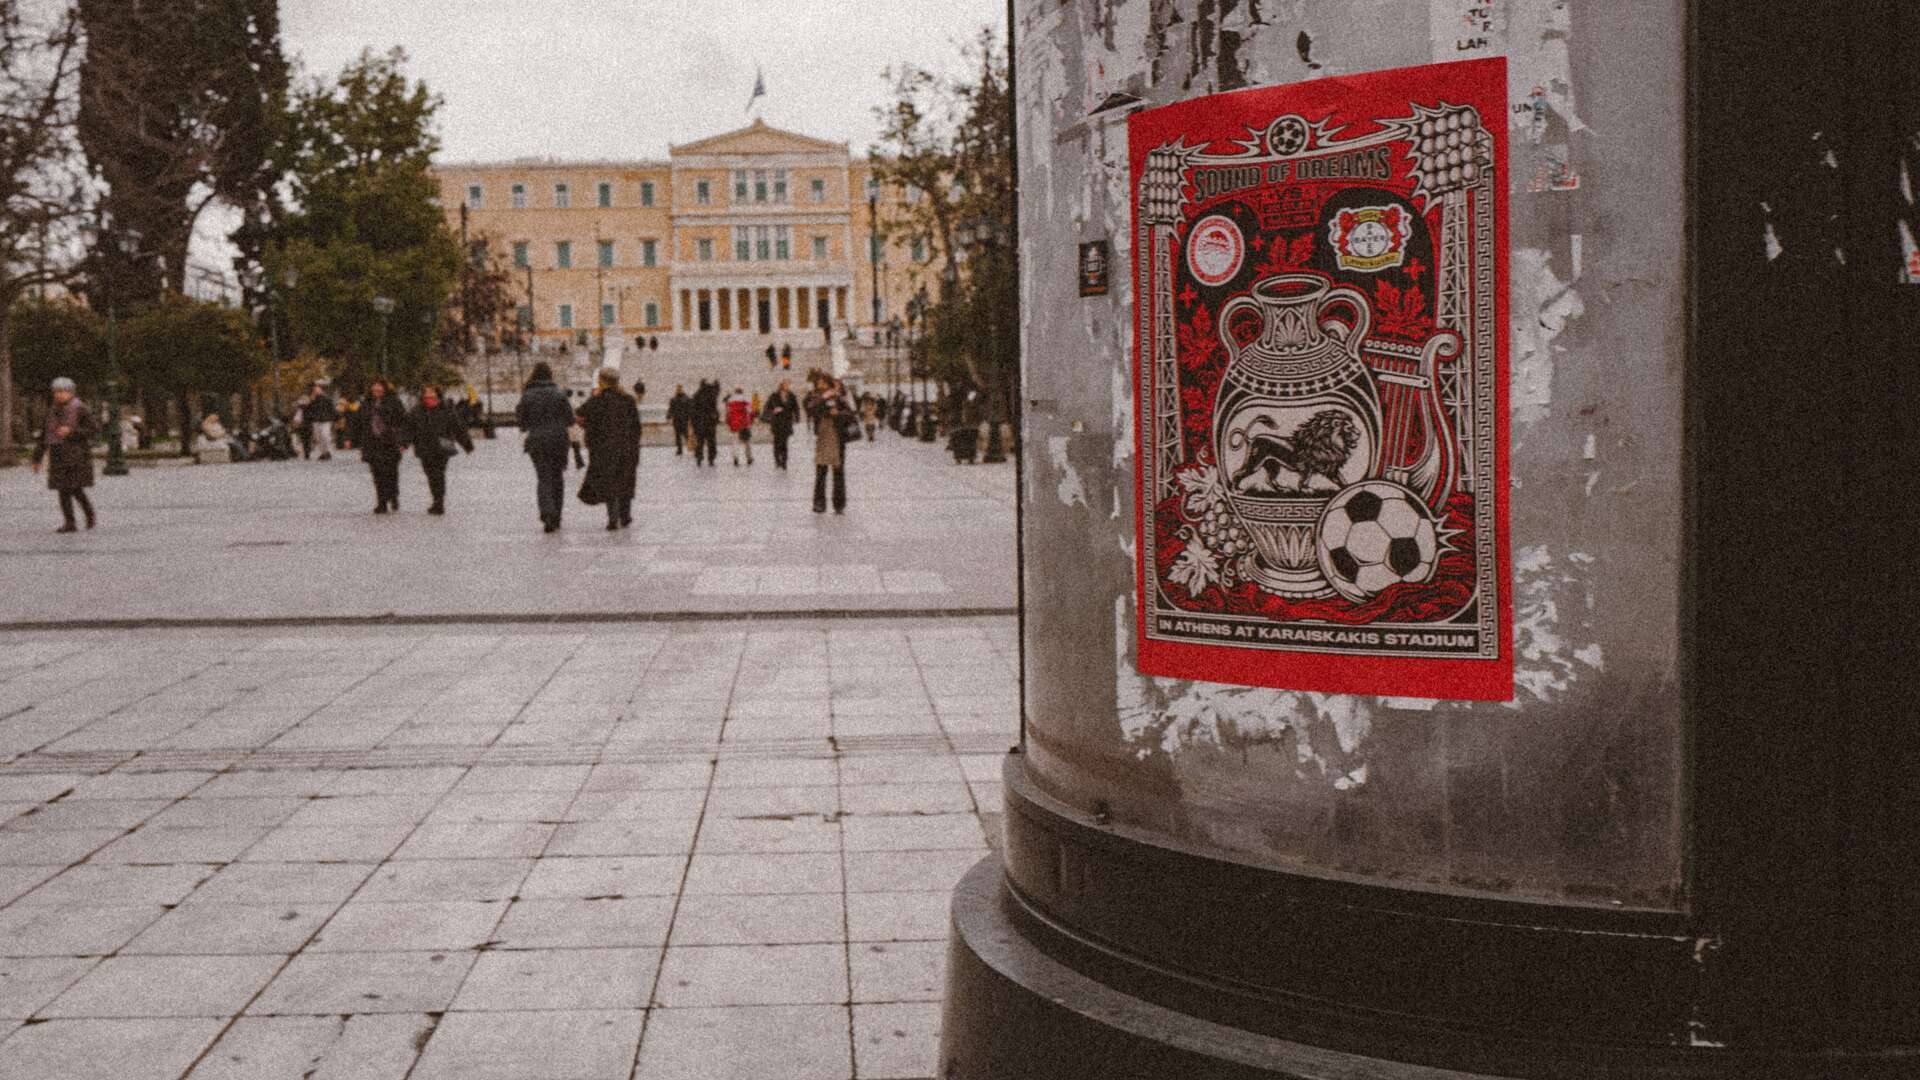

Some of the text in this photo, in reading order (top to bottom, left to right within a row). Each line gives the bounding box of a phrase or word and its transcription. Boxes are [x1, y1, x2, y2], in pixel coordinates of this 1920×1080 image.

[1193, 146, 1392, 202] SOUND OF DREAMS
[1159, 619, 1474, 647] IN ATHENS AT KARAISKAKIS STADIUM
